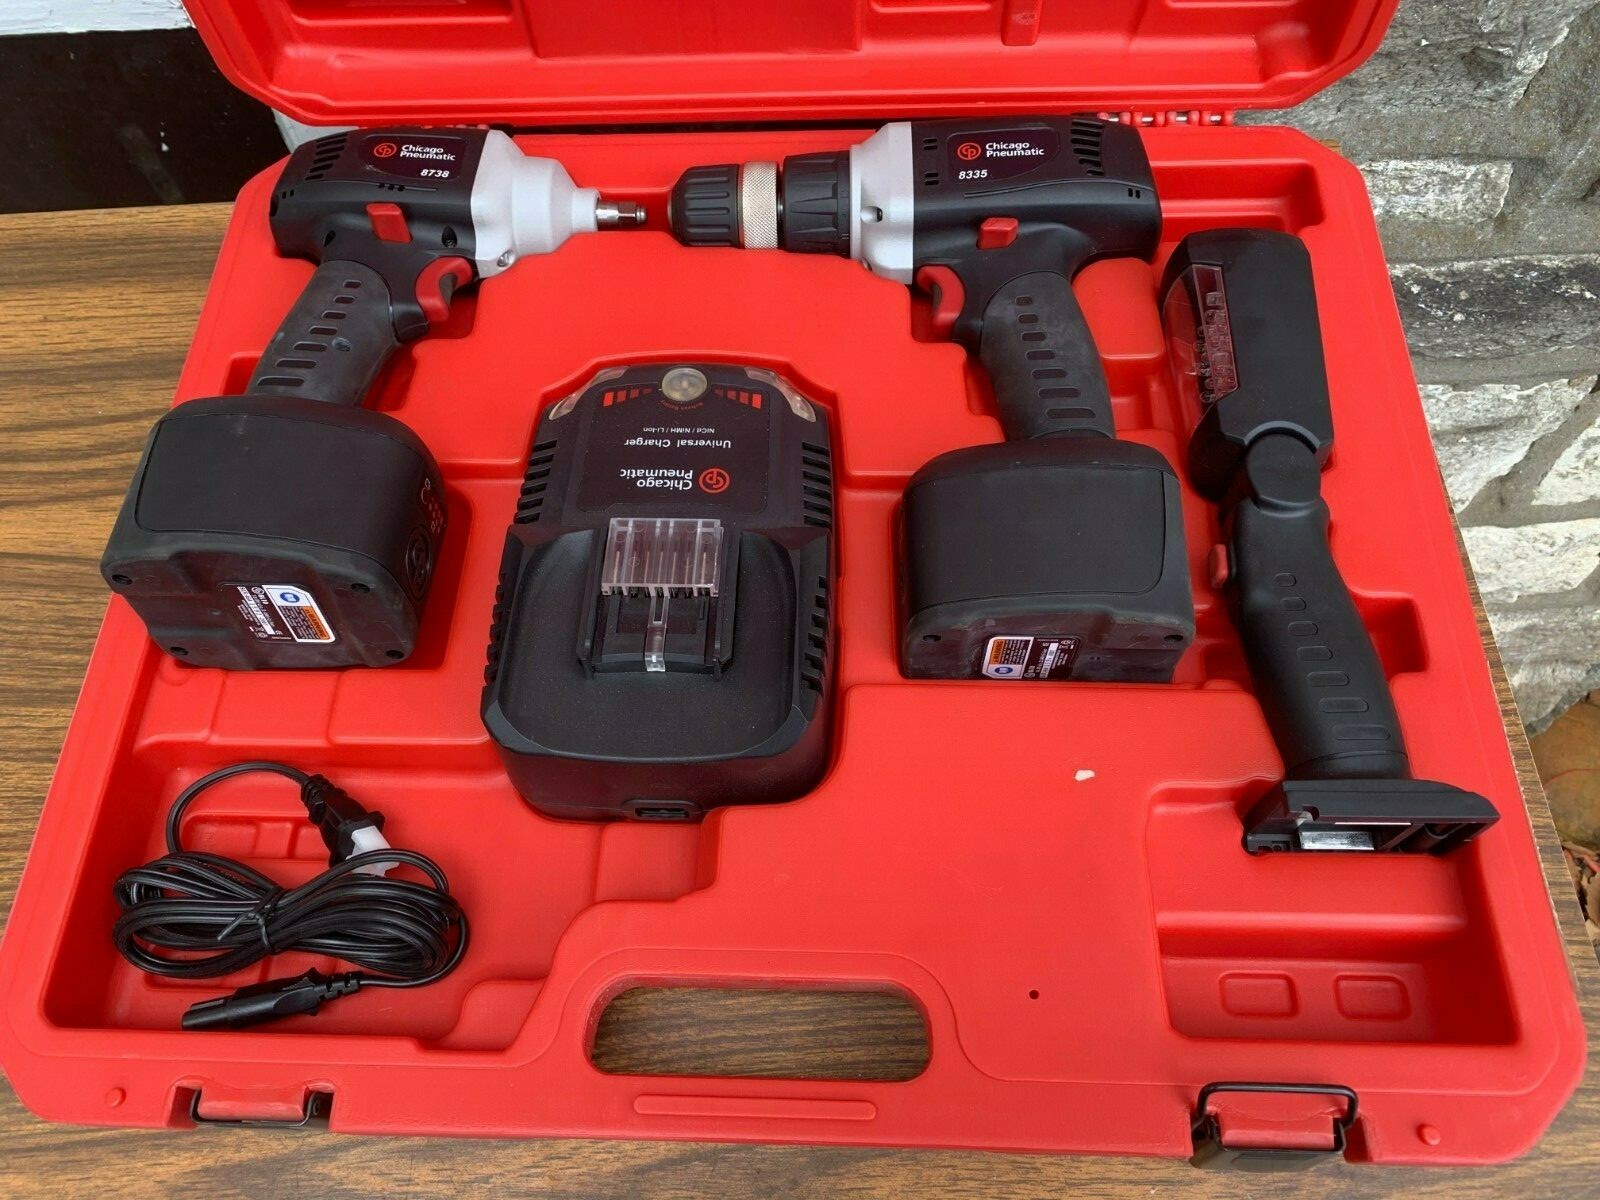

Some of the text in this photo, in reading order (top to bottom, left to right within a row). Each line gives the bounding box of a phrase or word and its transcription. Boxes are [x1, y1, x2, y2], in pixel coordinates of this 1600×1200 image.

[401, 144, 444, 153] Chicago
[985, 142, 1030, 151] Chicago
[400, 151, 456, 161] Pneumatic
[986, 148, 1045, 158] Pneumatic
[420, 168, 450, 178] 8738
[958, 169, 988, 180] 8335
[624, 437, 732, 449] Universal Charger
[619, 468, 693, 480] Pneumatic
[636, 478, 693, 491] Chicago
